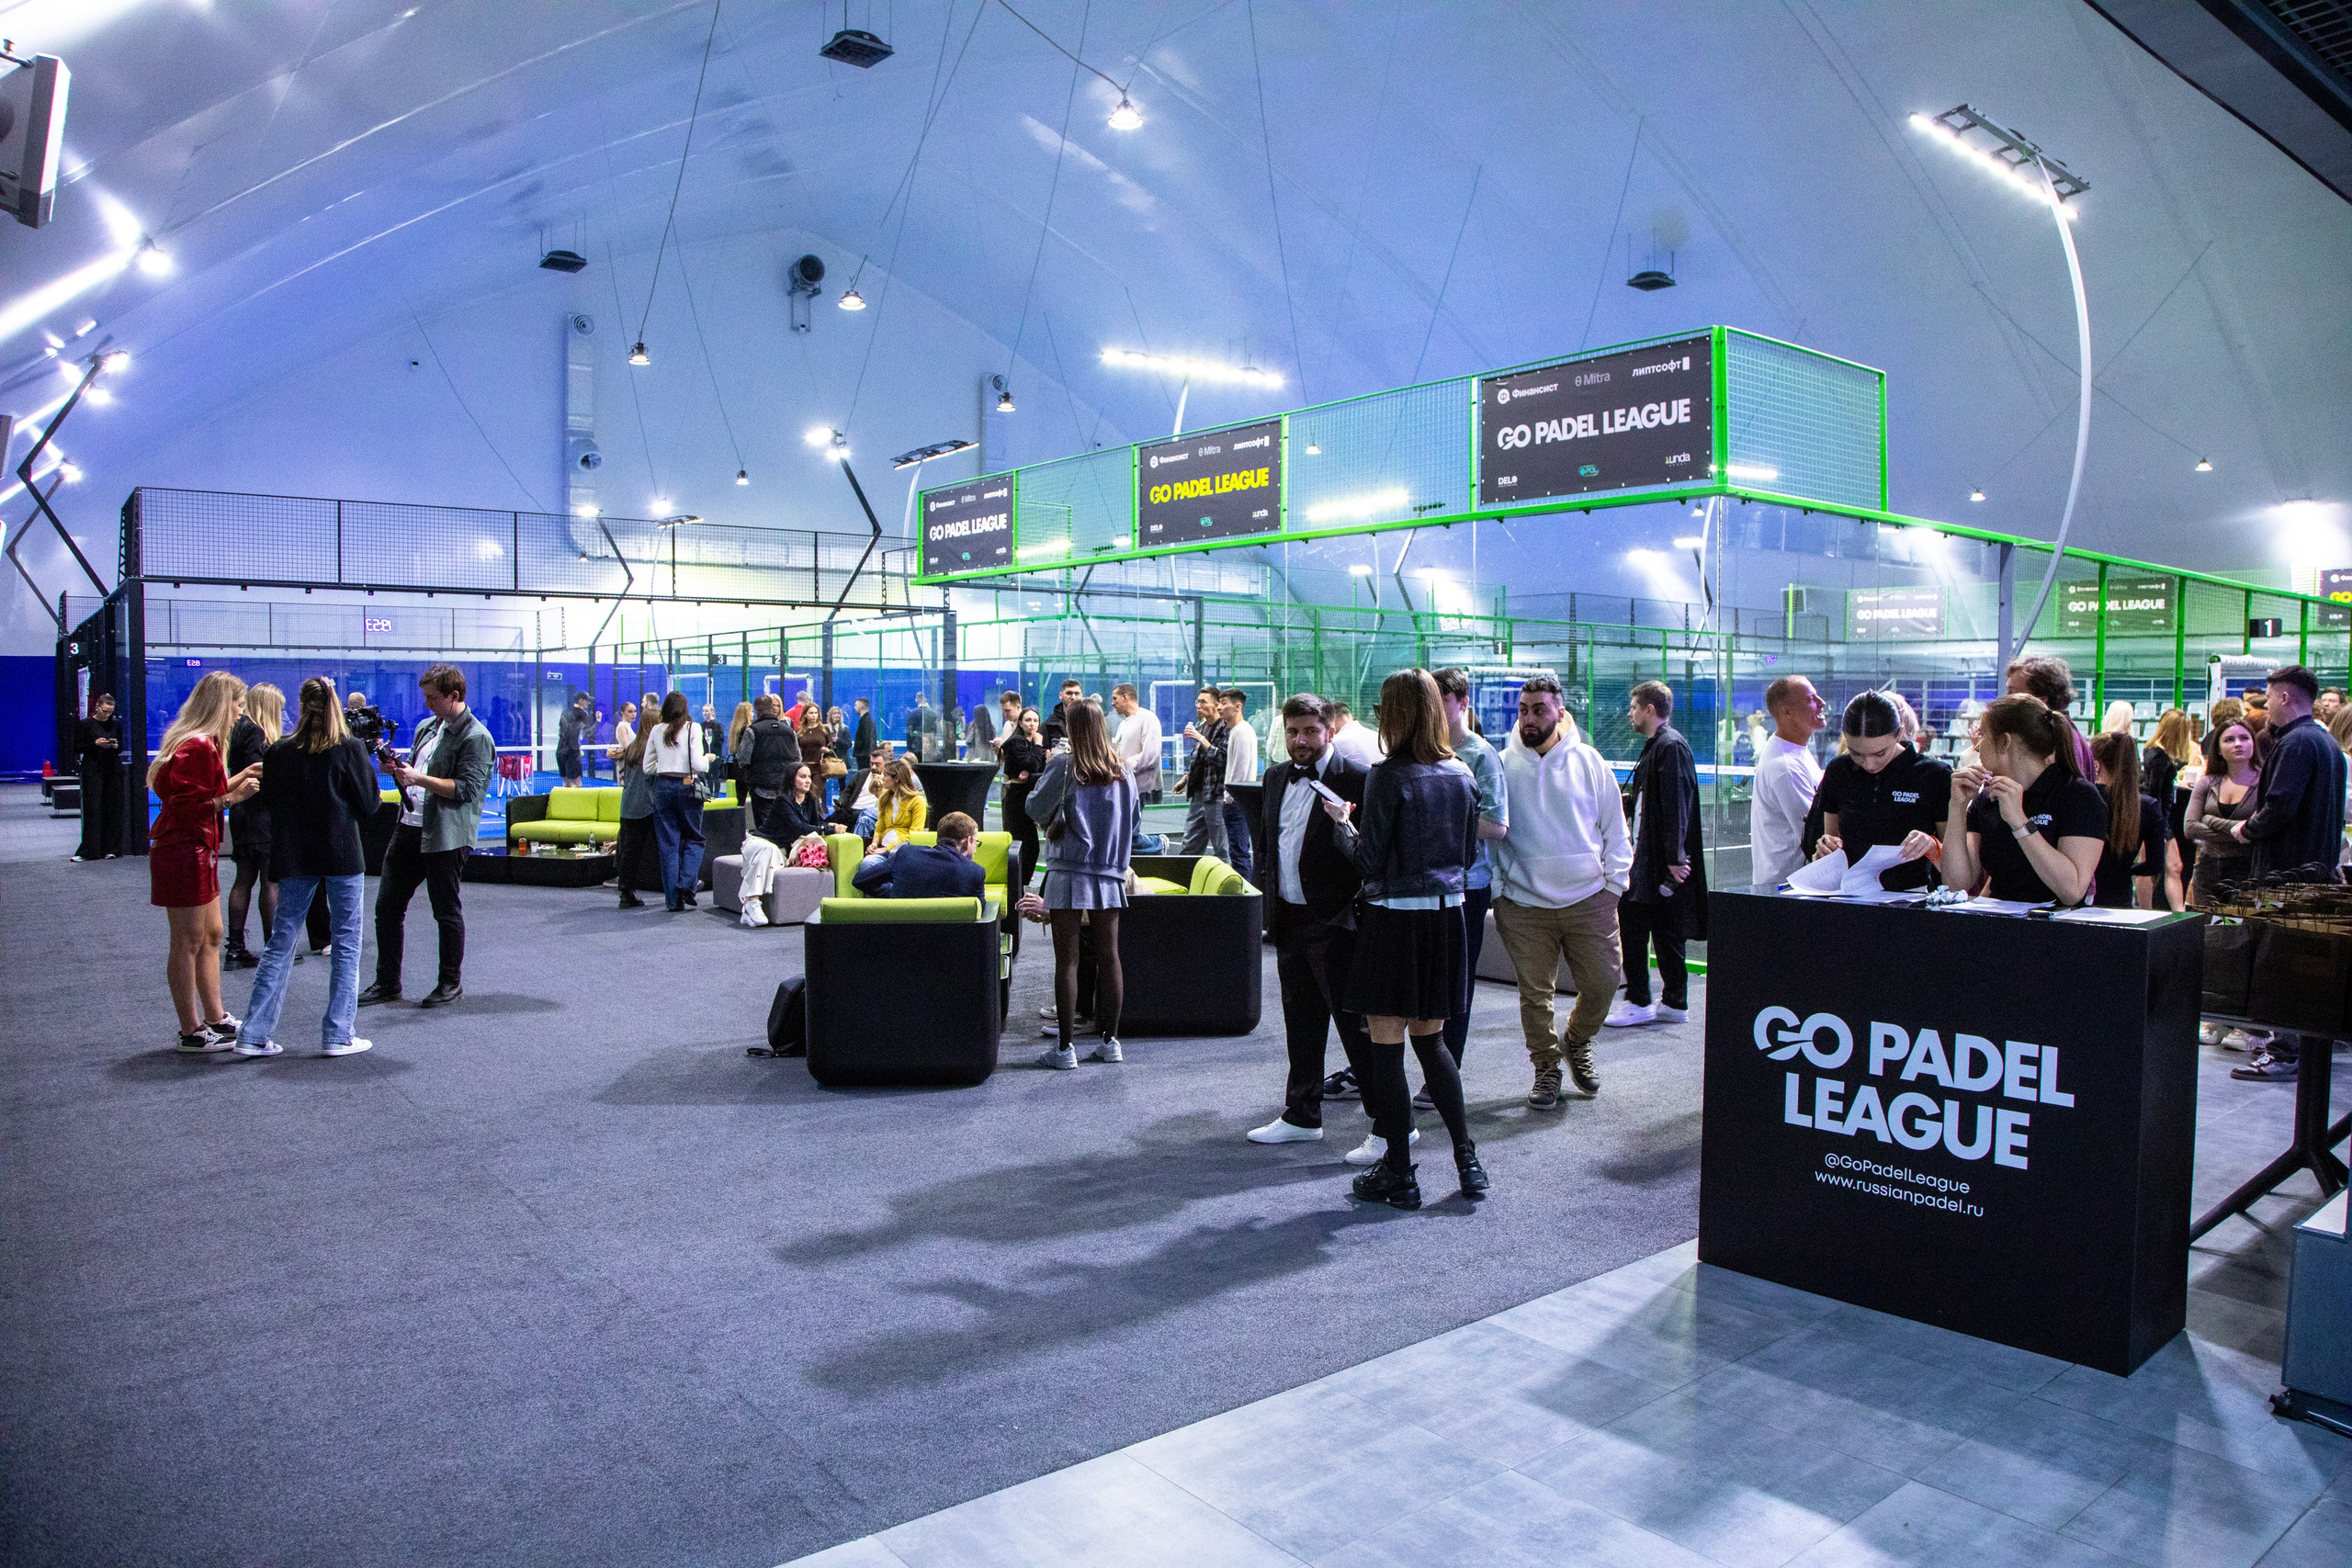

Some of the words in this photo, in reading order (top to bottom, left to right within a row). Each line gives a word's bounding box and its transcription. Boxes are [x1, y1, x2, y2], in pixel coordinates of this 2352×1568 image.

[1632, 359, 1681, 377] липтсофт
[1584, 373, 1611, 386] Mitra
[1512, 383, 1559, 399] Финансист
[1497, 423, 1532, 450] GO
[1535, 413, 1600, 445] PADEL
[1602, 398, 1690, 434] LEAGUE
[1149, 484, 1171, 504] GO
[1173, 477, 1213, 501] PADEL
[1216, 467, 1270, 494] LEAGUE
[929, 525, 944, 541] GO
[944, 520, 971, 539] PADEL
[971, 513, 1007, 534] LEAGUE
[1856, 609, 1872, 620] GO
[1873, 608, 1900, 619] PADEL
[1902, 607, 1937, 618] LEAGUE
[2068, 601, 2086, 612] GO
[2122, 599, 2165, 611] LEAGUE
[2264, 619, 2273, 637] 1
[70, 642, 79, 655] 3
[1498, 642, 1502, 654] 1
[718, 655, 724, 664] 3
[775, 655, 781, 664] 2
[1183, 664, 1189, 673] 2
[1753, 1005, 1854, 1069] GO
[1869, 1021, 2075, 1108] PADEL
[1784, 1071, 2030, 1170] LEAGUE
[1824, 1152, 1970, 1194] @GoPadelLeague
[1815, 1170, 1984, 1218] www.russianpadel.ru
